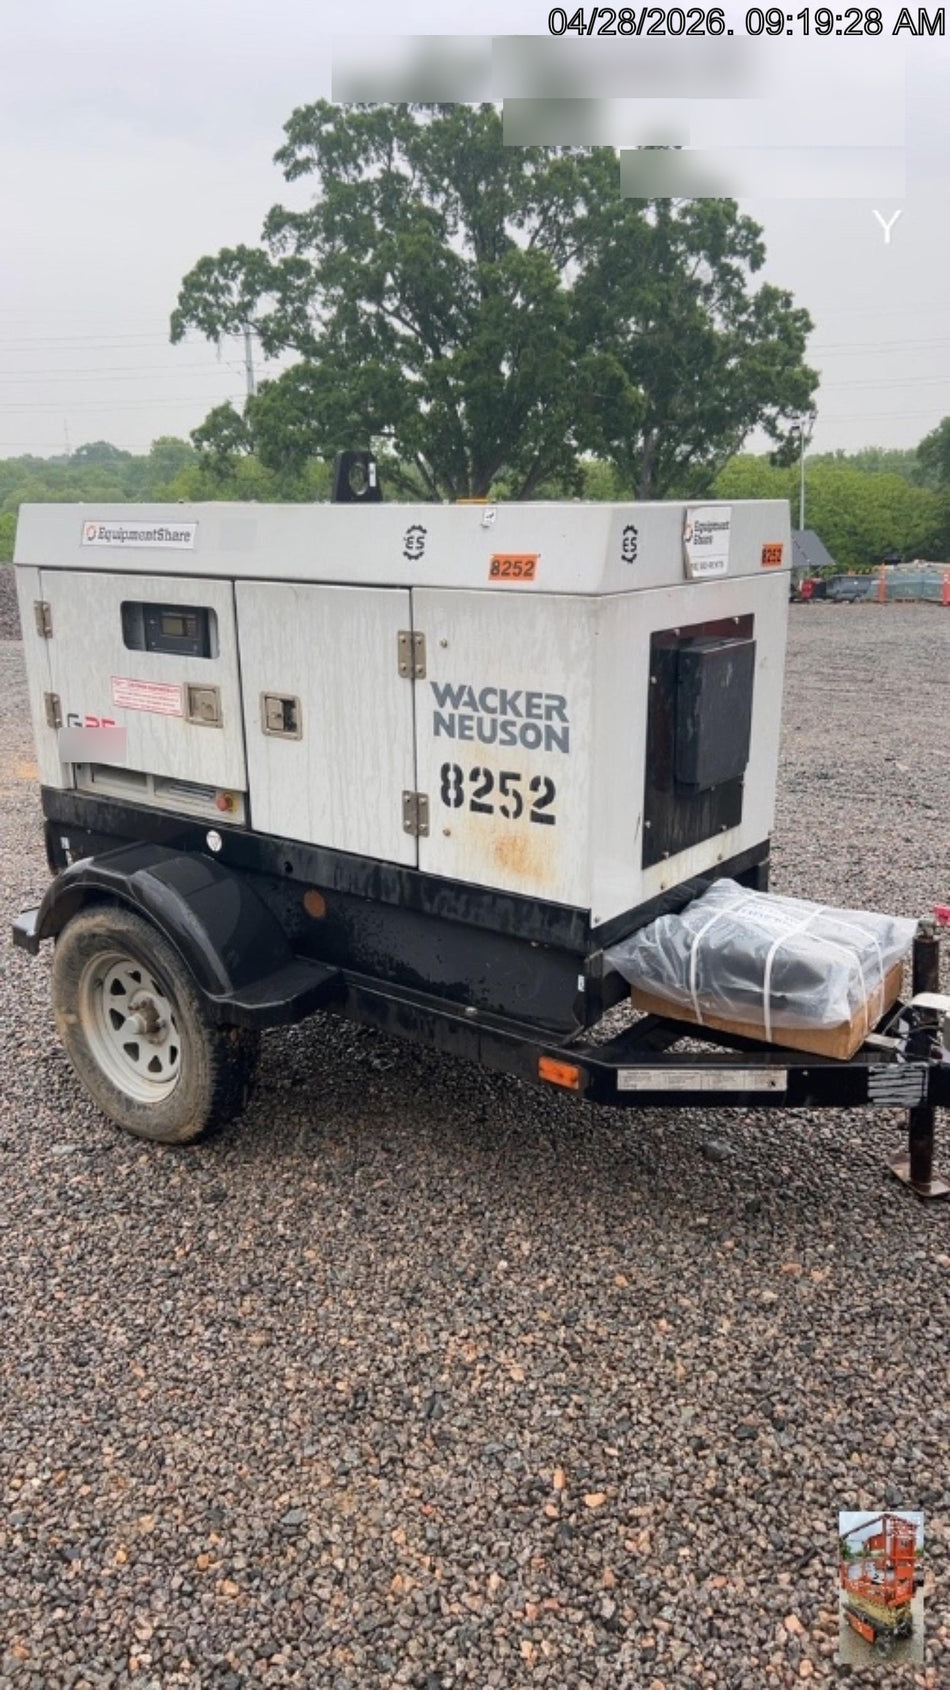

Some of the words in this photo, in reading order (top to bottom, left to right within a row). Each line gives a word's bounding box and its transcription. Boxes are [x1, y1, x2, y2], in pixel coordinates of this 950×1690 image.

[98, 526, 192, 543] EquipmentShare
[490, 560, 534, 577] 8252
[430, 681, 569, 723] WACKER
[433, 710, 570, 754] NEUSON
[440, 762, 557, 826] 8252
